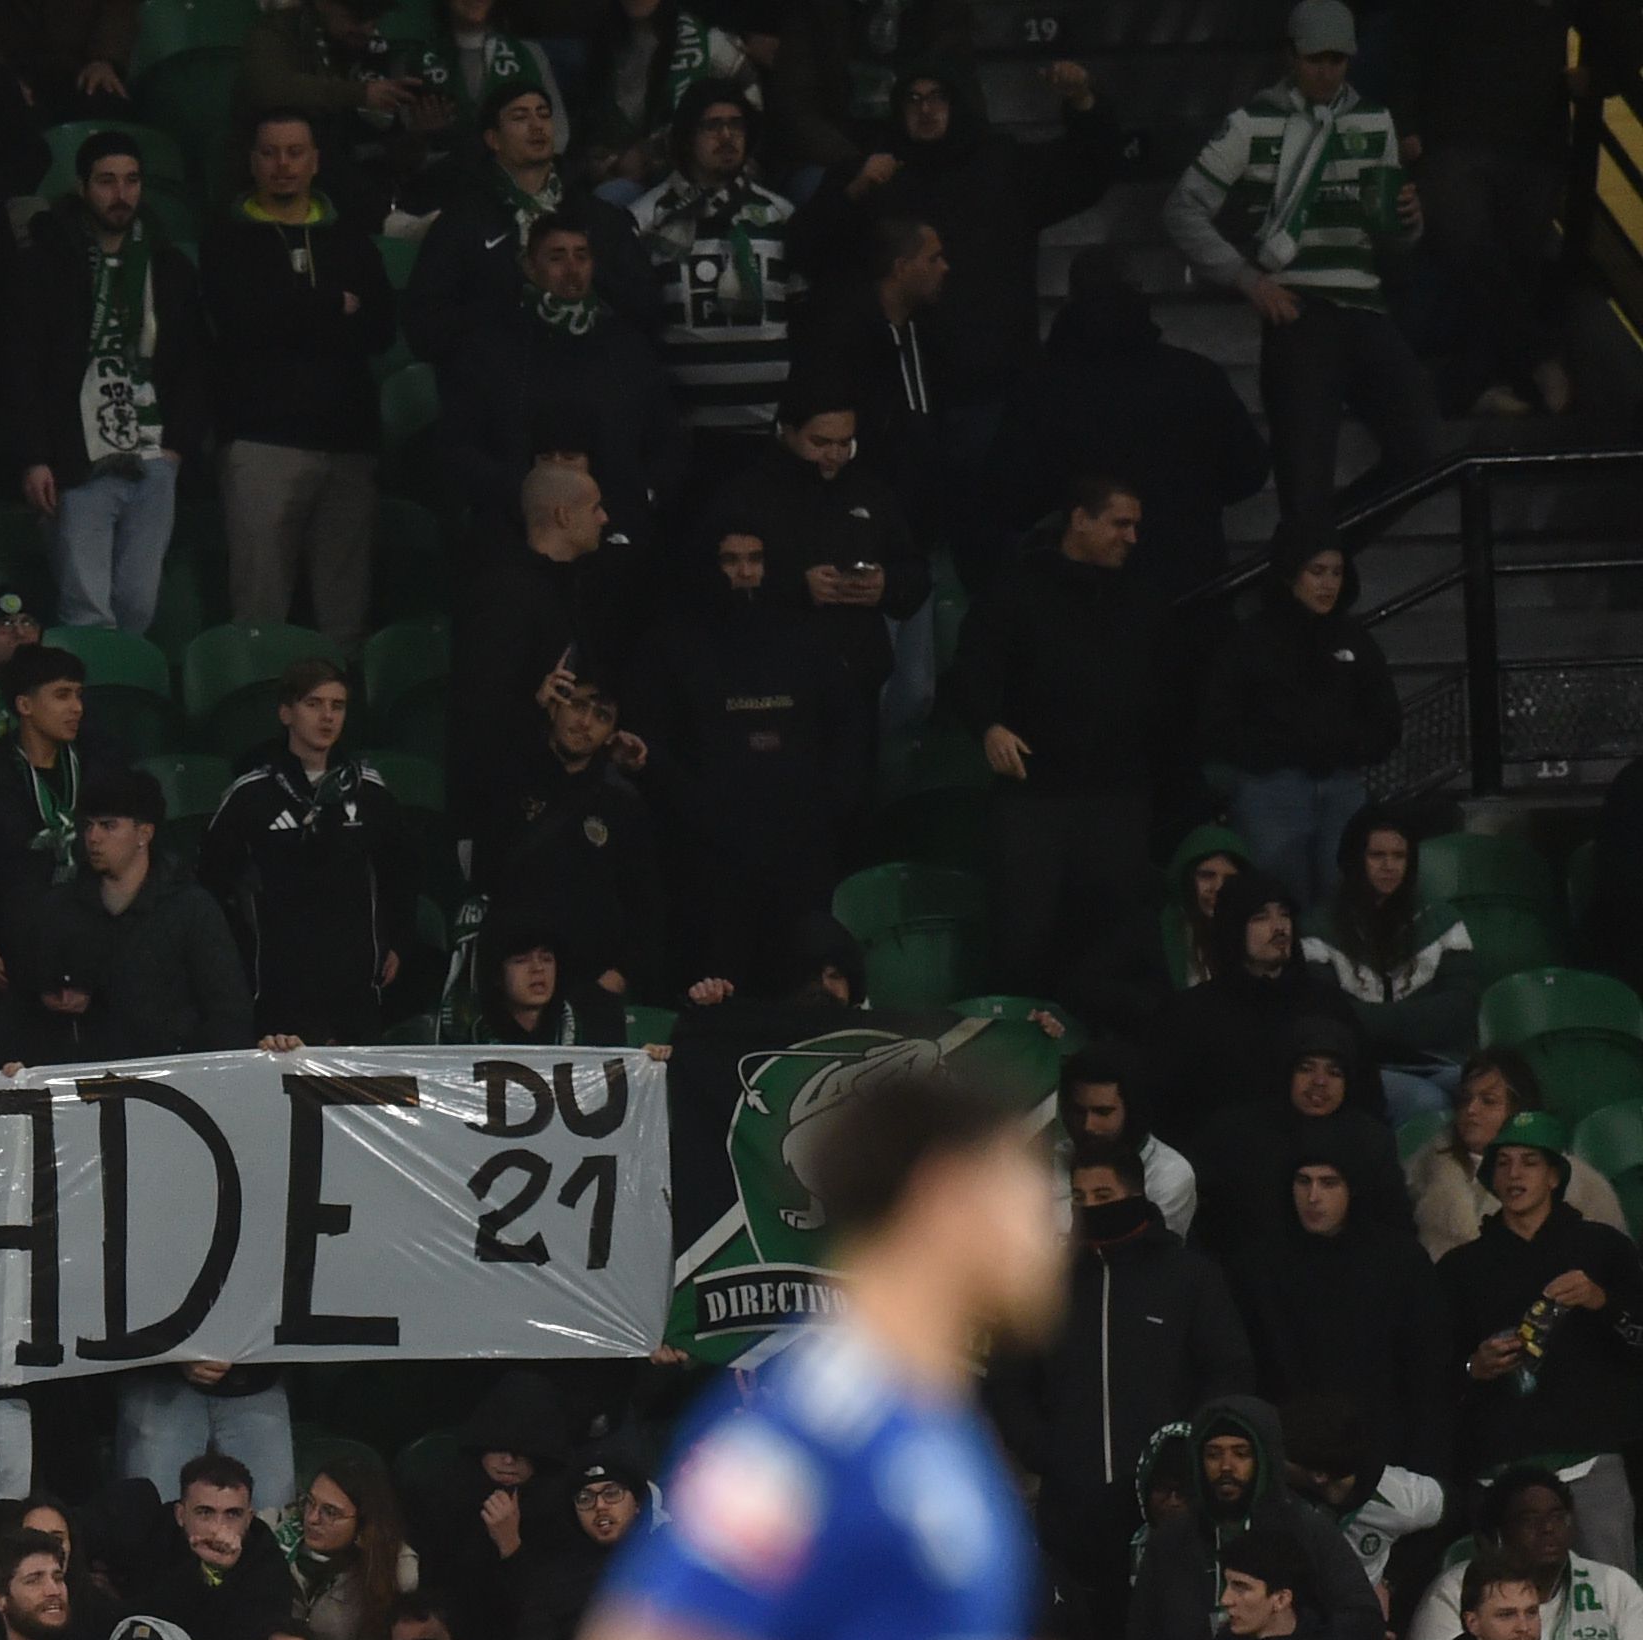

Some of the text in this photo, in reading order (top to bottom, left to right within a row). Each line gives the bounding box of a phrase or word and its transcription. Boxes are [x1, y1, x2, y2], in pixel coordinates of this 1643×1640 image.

[1024, 18, 1057, 42] 19
[465, 1057, 629, 1140] DU
[466, 1152, 616, 1270] 21
